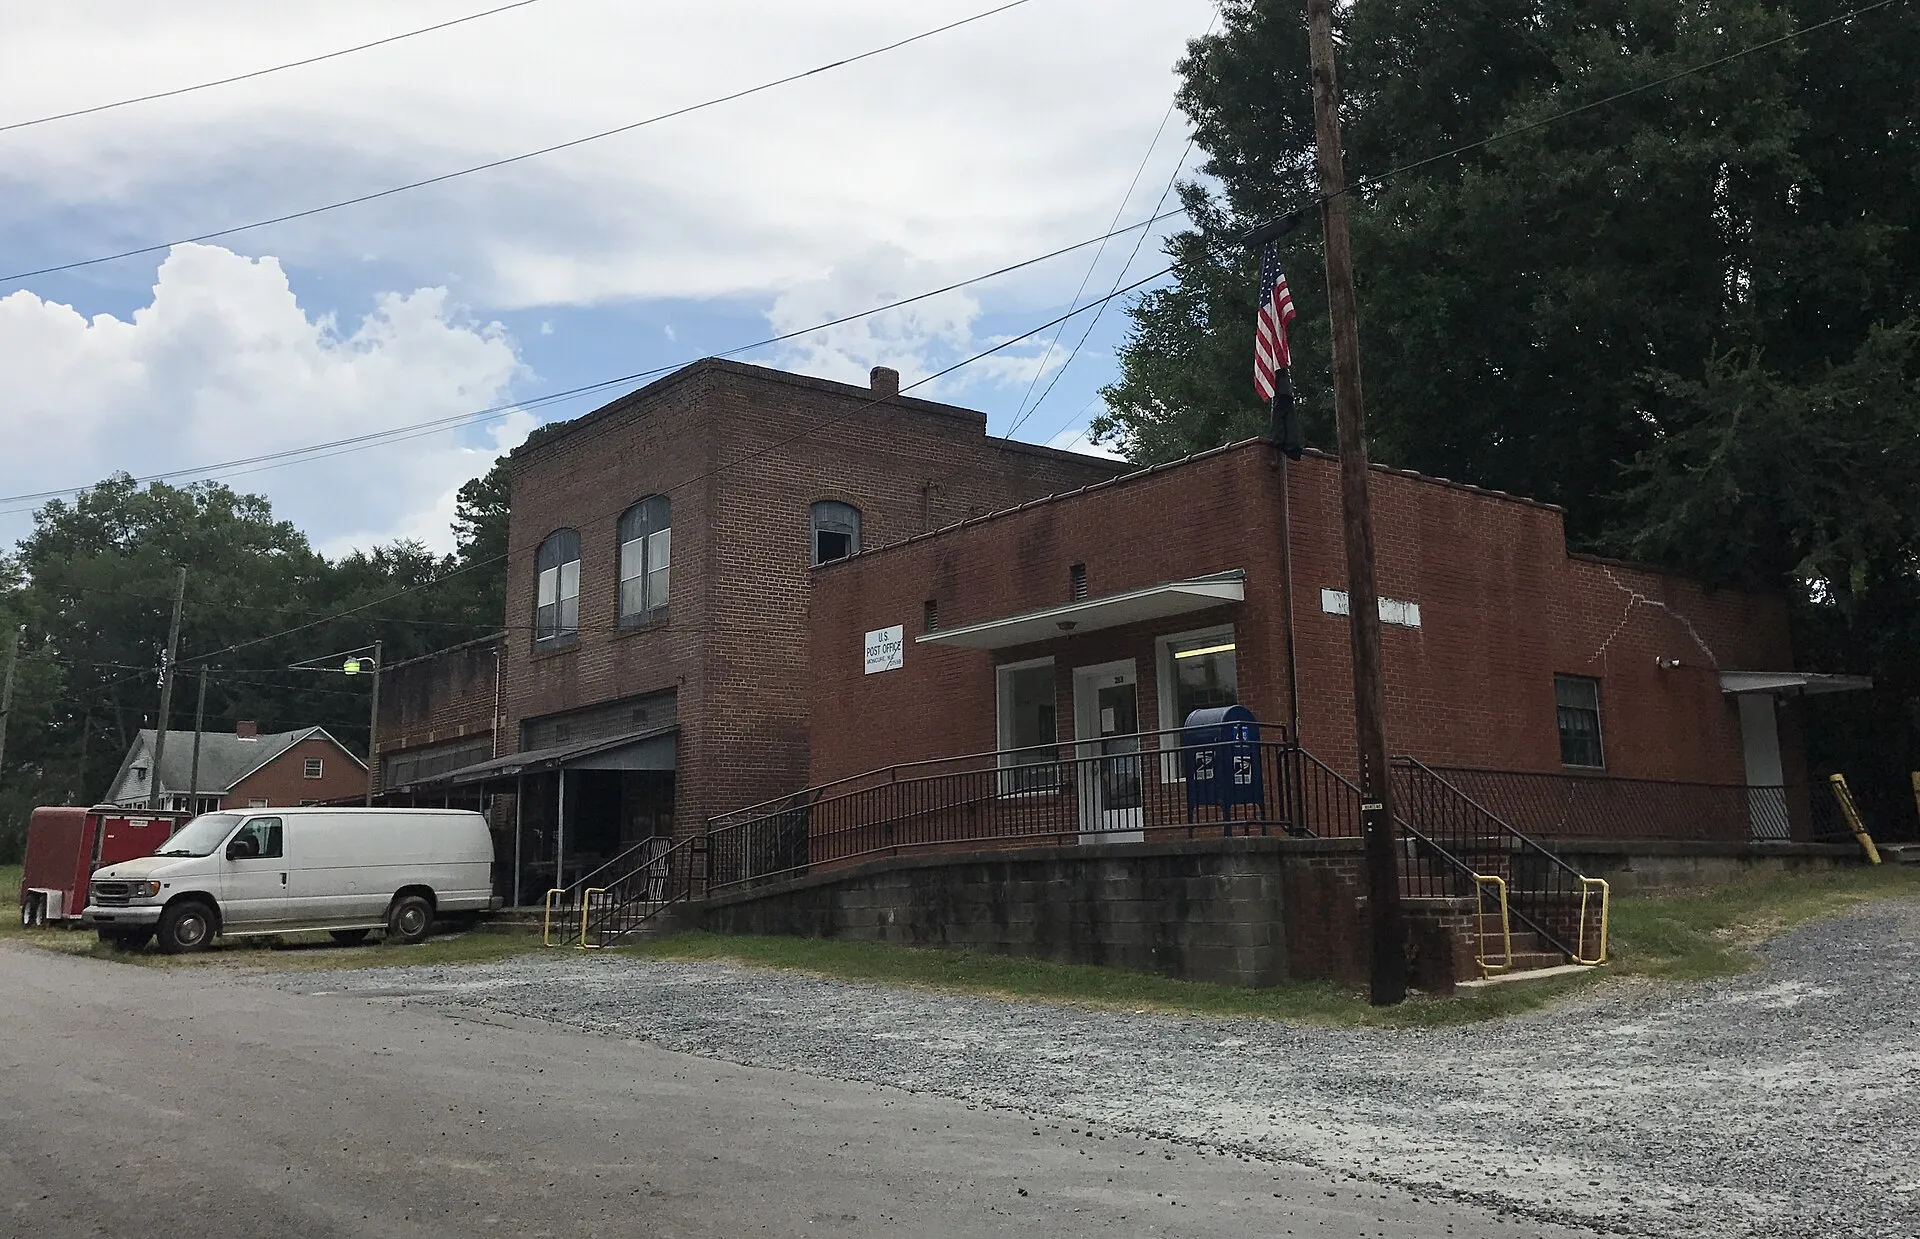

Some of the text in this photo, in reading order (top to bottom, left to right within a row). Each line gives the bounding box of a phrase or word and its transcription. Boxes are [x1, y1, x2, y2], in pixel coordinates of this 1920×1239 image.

[878, 631, 889, 642] U.S.
[867, 640, 901, 657] POST OFFICE
